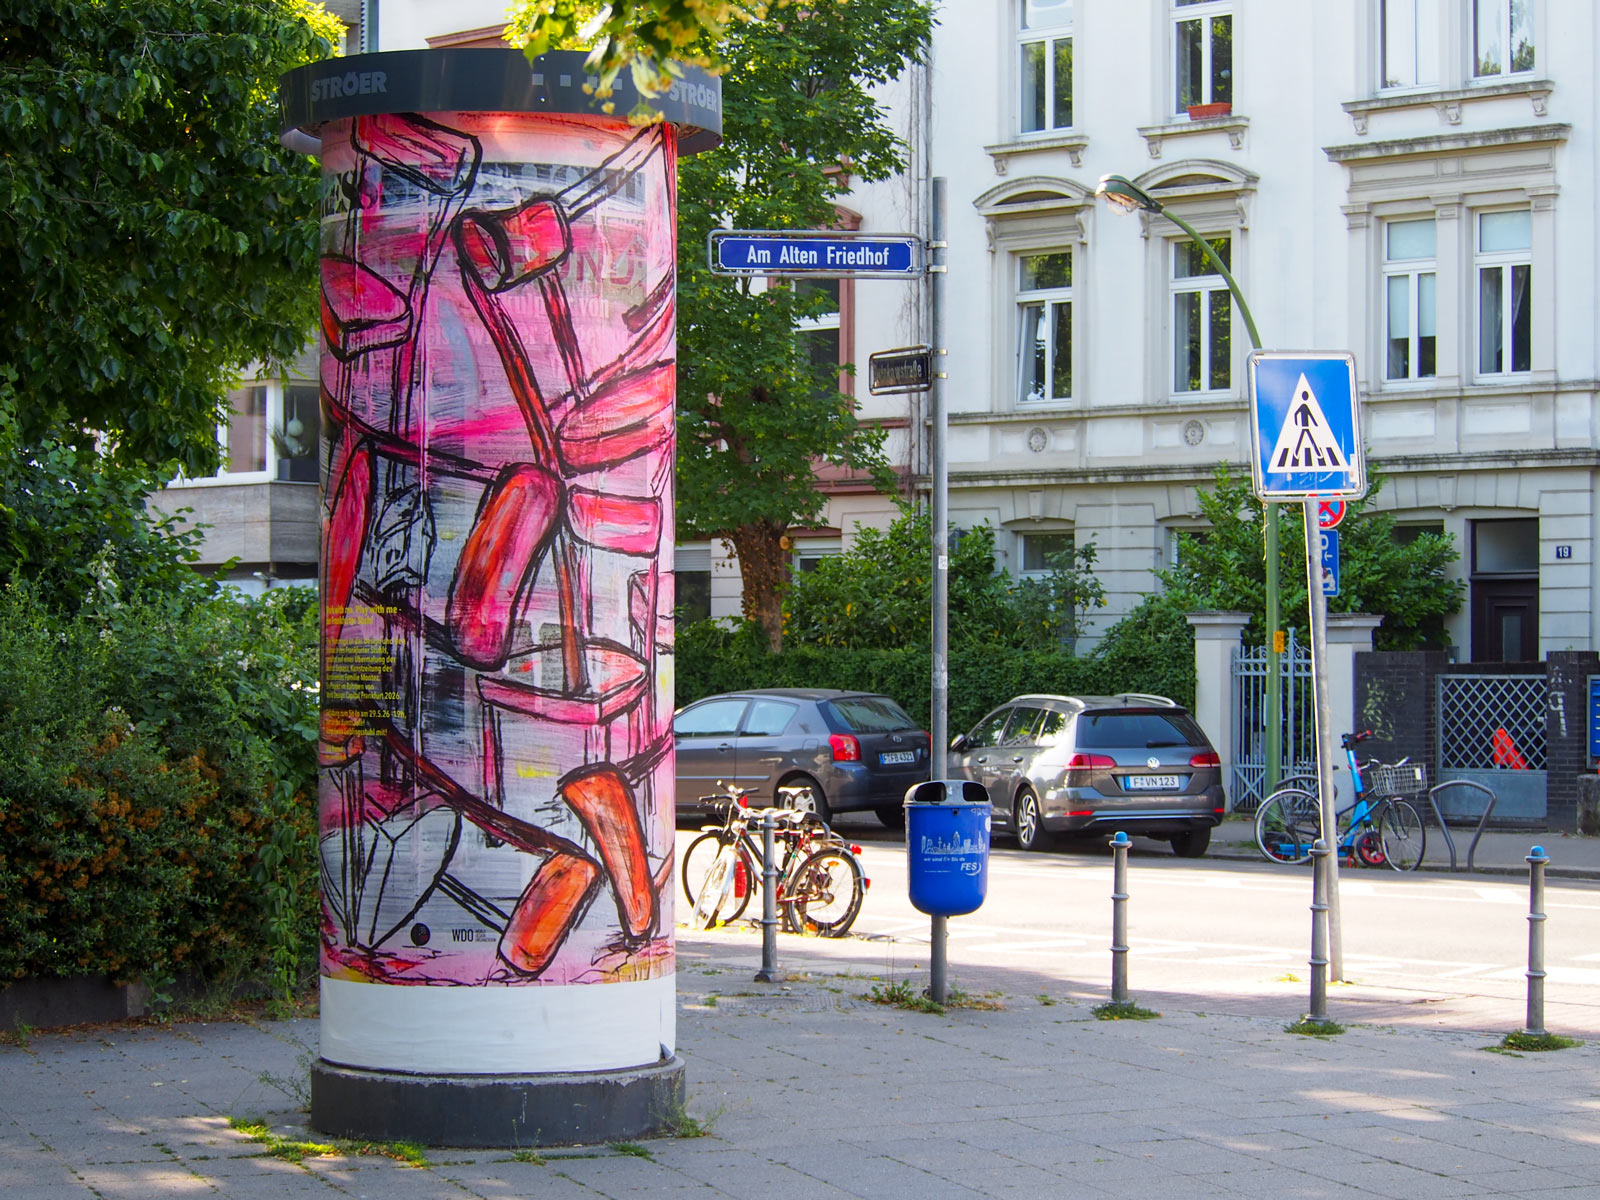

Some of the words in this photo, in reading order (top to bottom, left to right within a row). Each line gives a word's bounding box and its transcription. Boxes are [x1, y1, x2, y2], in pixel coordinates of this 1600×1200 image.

[311, 72, 387, 101] STRÖER
[669, 80, 717, 112] STRÖER
[747, 245, 770, 264] Am
[779, 246, 817, 264] Alten
[827, 246, 889, 266] Friedhof
[1558, 546, 1569, 558] 19
[386, 605, 398, 614] me
[369, 710, 391, 719] 29.5.26
[1145, 776, 1158, 786] VN
[1160, 775, 1176, 786] 123
[960, 862, 978, 871] FES
[452, 928, 474, 942] WDO
